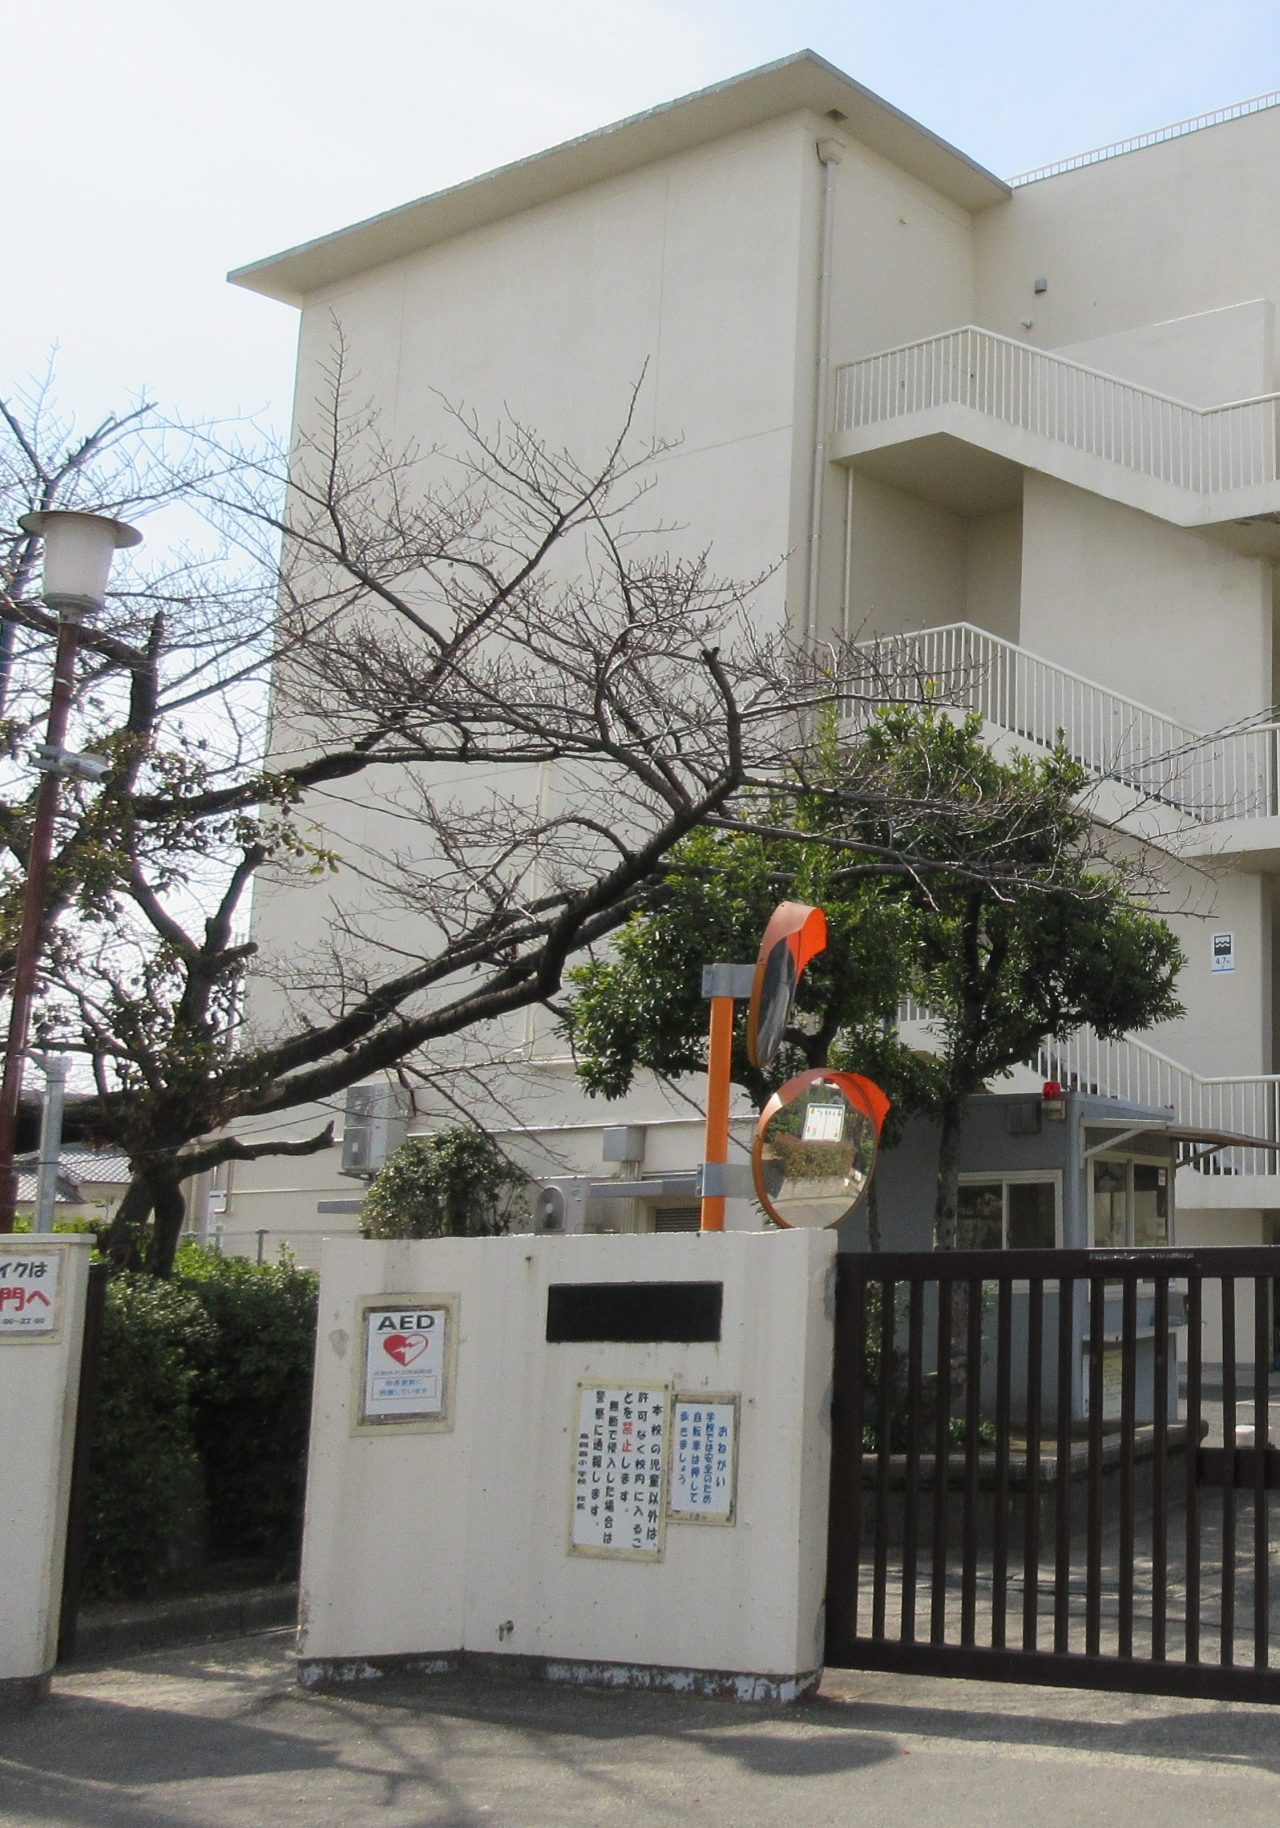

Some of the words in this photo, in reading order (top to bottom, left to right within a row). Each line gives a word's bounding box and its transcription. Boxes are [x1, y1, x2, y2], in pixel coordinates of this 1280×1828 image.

[377, 1314, 435, 1331] AED
[716, 1425, 728, 1488] おねがい
